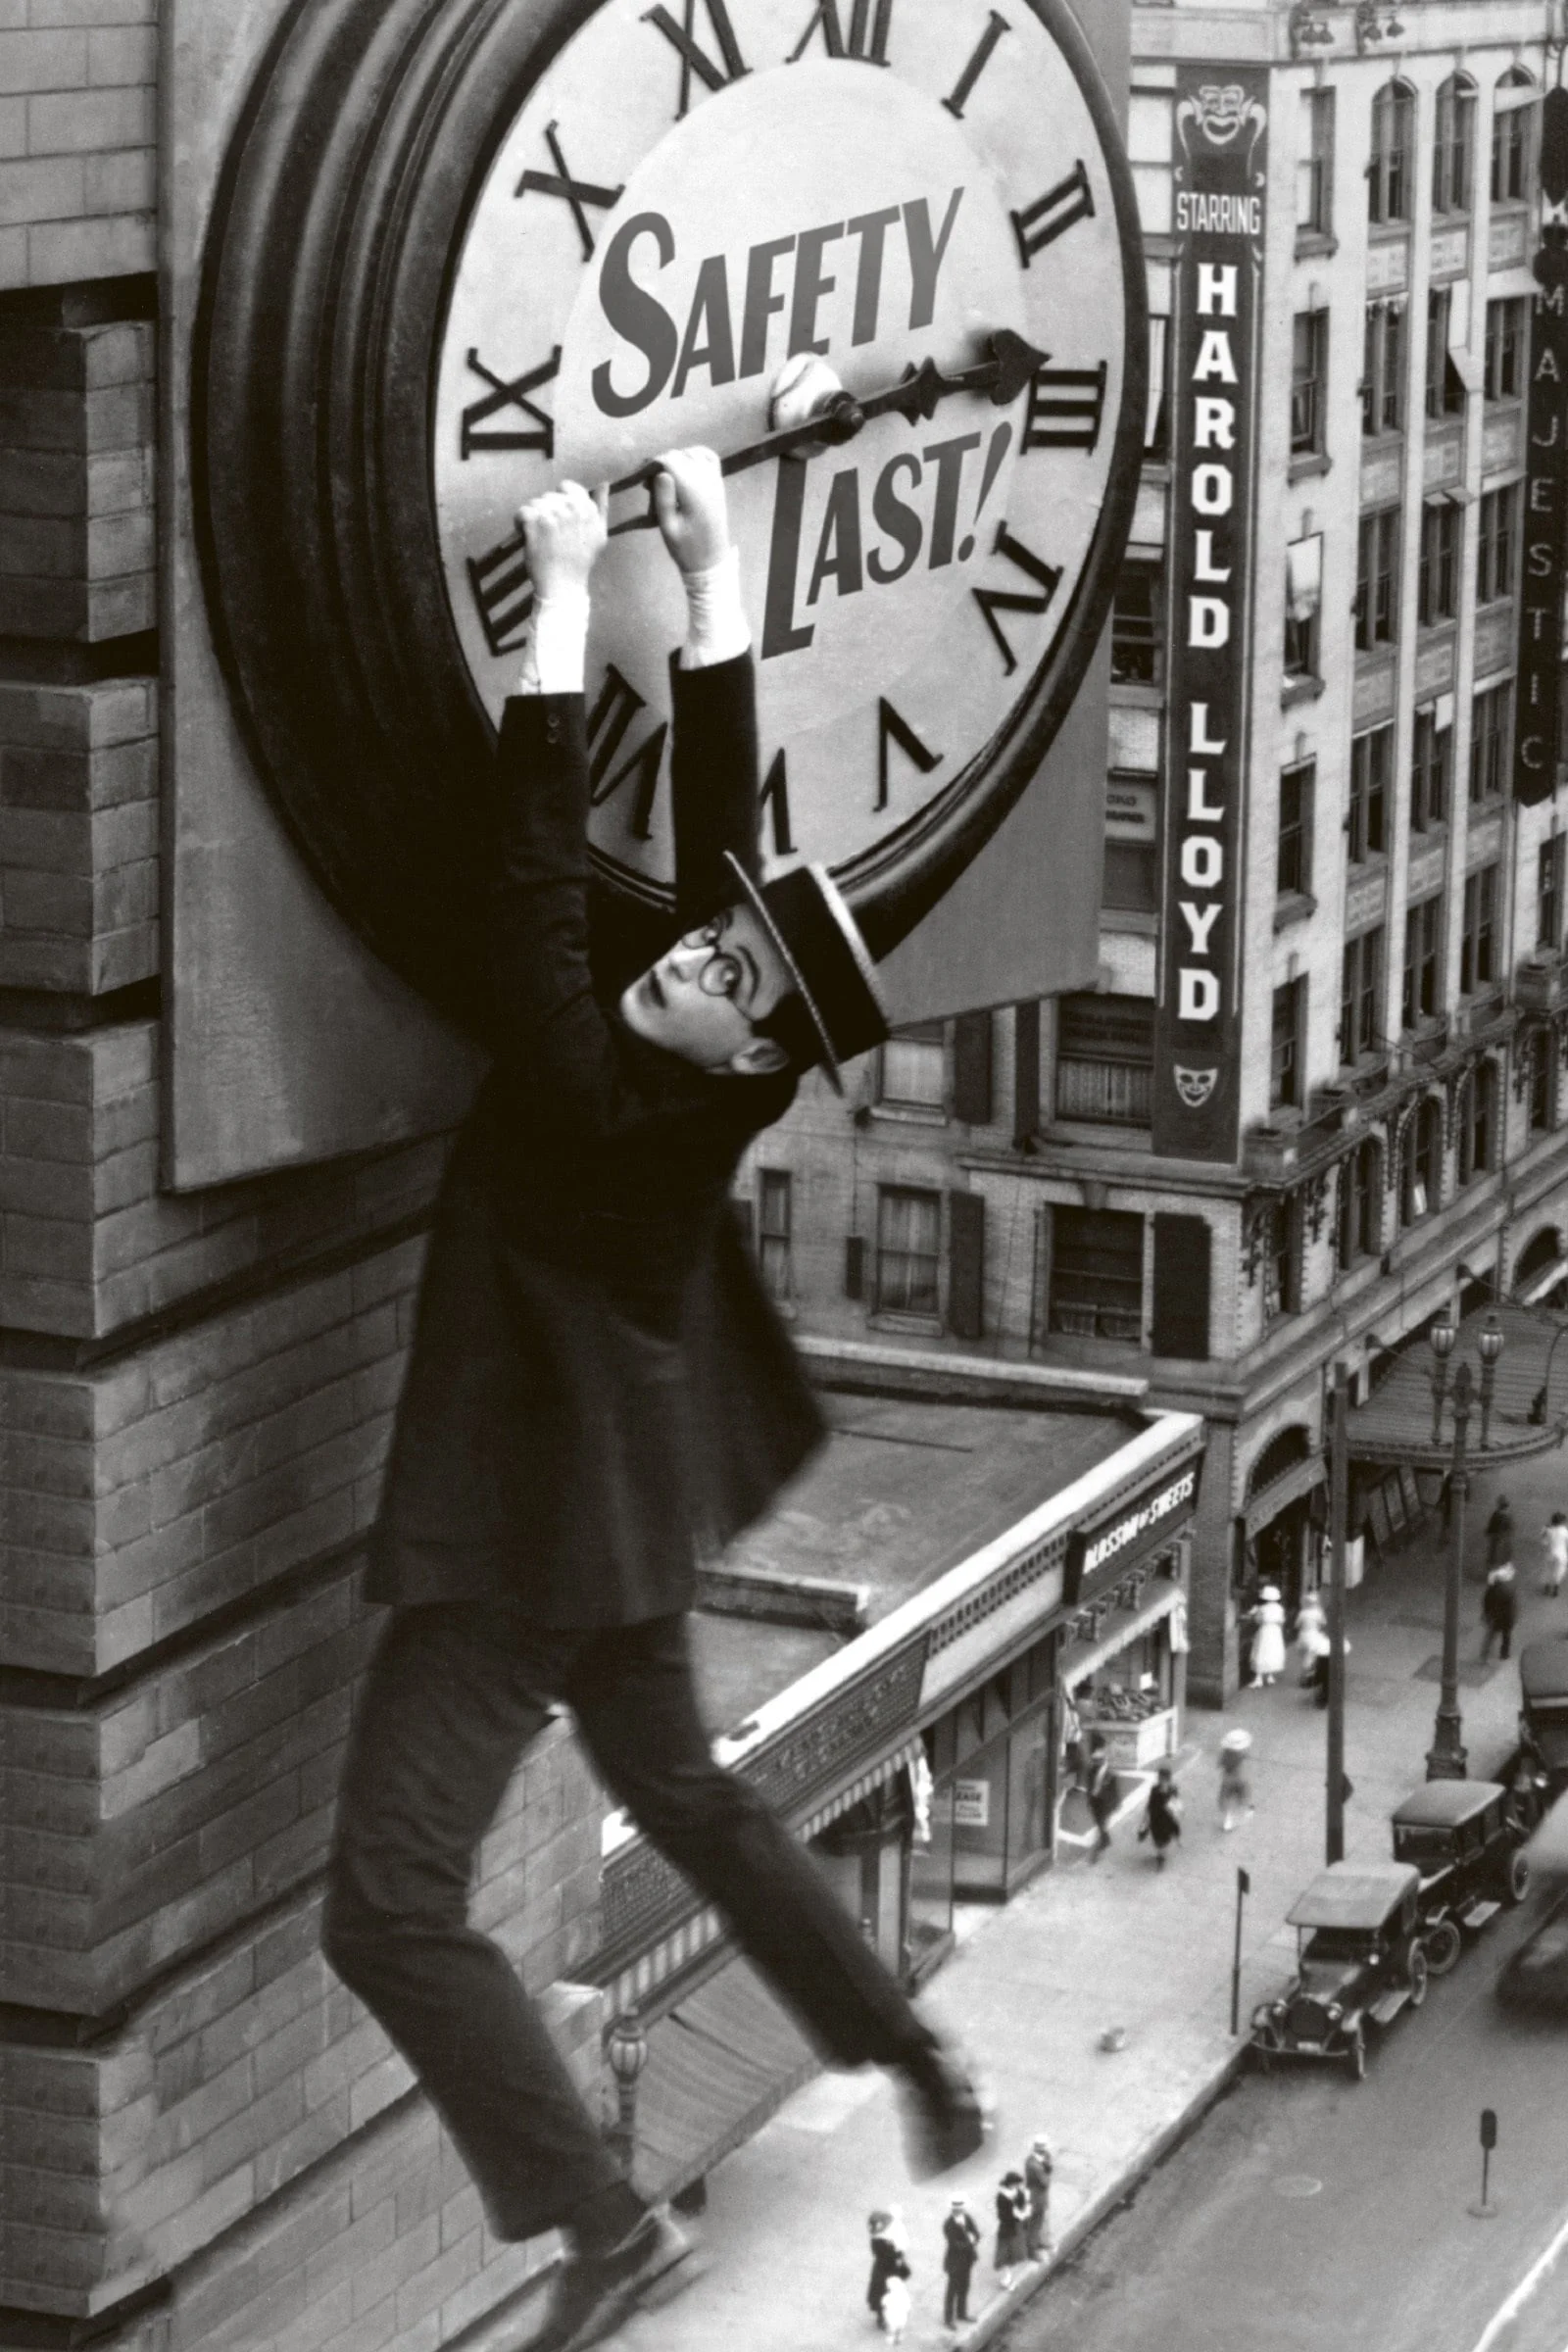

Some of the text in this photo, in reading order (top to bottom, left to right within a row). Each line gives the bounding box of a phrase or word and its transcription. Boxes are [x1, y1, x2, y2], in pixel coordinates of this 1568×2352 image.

[592, 185, 965, 418] SAFETY
[1176, 190, 1261, 235] STARRING
[761, 420, 1012, 661] LAST!
[1177, 263, 1239, 1021] HAROLD LLOYD
[1521, 282, 1565, 770] MAJESTIC
